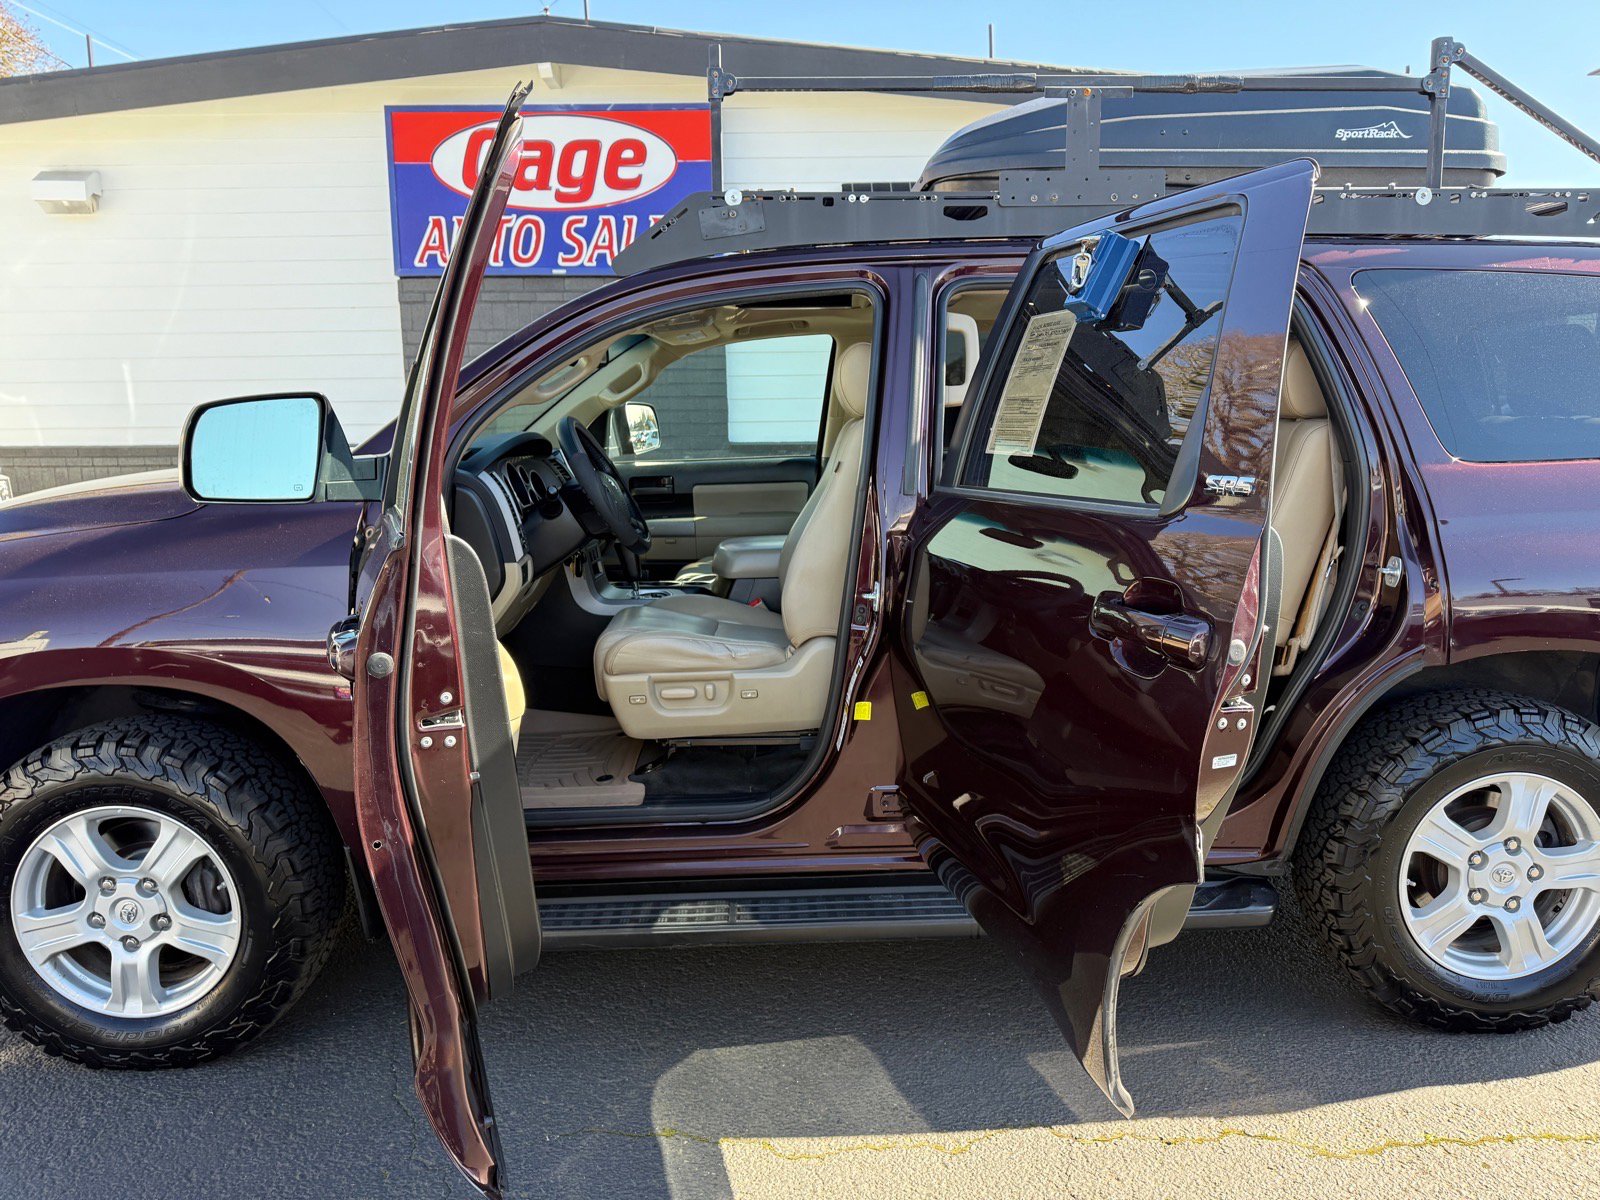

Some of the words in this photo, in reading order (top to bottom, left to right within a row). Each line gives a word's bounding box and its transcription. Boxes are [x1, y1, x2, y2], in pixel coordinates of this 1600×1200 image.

[1335, 128, 1399, 141] SportRack
[414, 215, 545, 267] ATO
[557, 214, 668, 267] SAL
